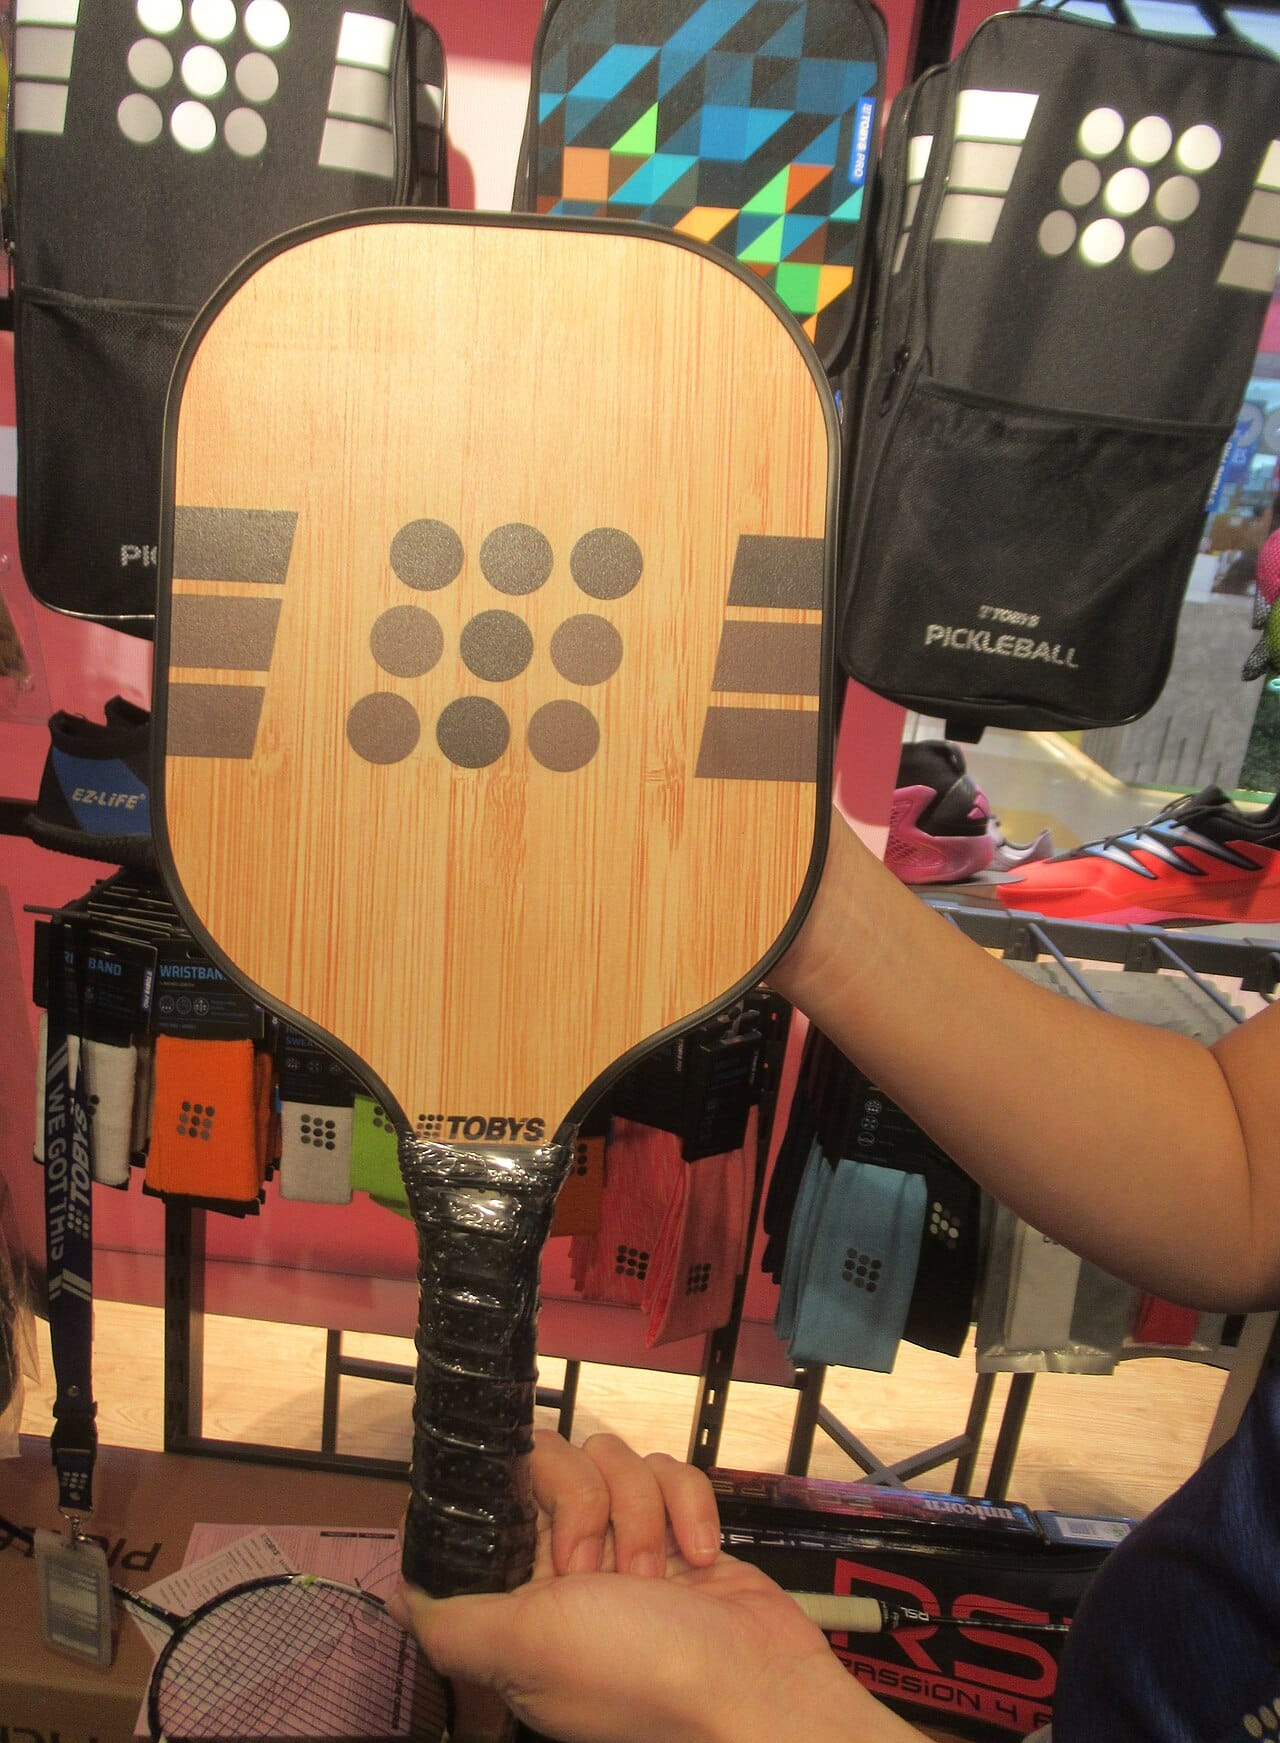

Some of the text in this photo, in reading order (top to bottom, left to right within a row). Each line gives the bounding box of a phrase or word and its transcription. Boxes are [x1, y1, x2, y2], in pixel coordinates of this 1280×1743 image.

[924, 623, 1080, 669] PICKLEBALL
[159, 964, 227, 981] WRISTBAN
[48, 1081, 66, 1136] WE
[447, 1115, 545, 1142] TOBYS
[48, 1137, 69, 1193] GOT
[70, 1103, 91, 1207] TOBYS
[924, 1499, 1016, 1521] unicorn
[830, 1558, 1073, 1699] RS
[900, 1605, 931, 1622] RSL
[995, 1699, 1018, 1722] 4
